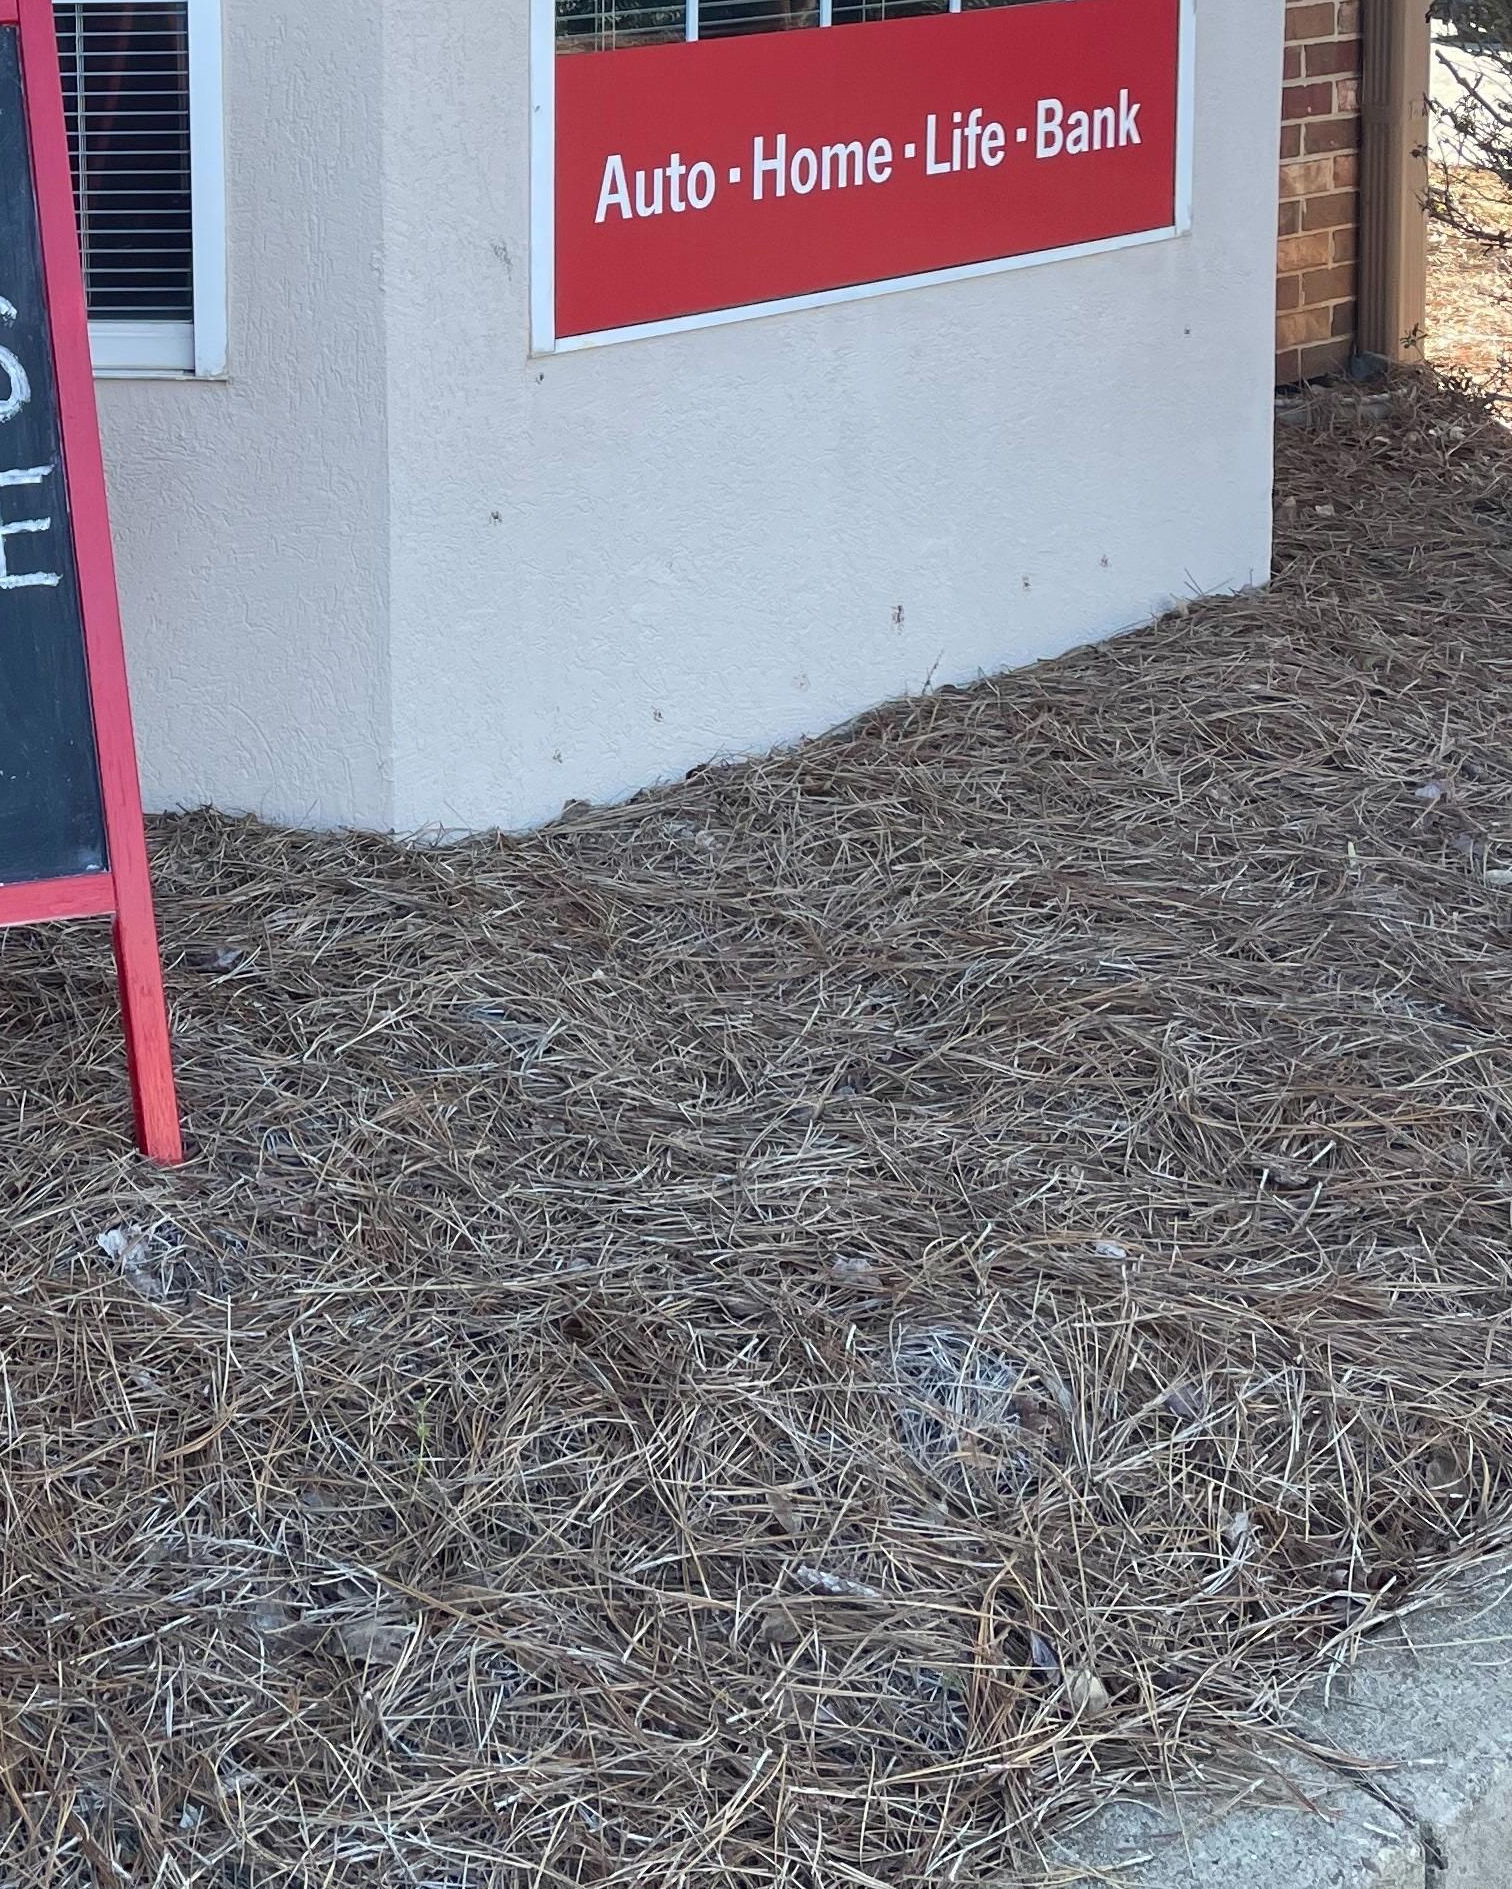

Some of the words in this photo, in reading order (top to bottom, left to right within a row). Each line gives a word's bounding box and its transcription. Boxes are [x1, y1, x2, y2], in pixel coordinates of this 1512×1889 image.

[593, 153, 716, 224] Auto
[751, 133, 893, 201] Home
[924, 107, 1006, 176] Life
[1035, 88, 1142, 159] Bank
